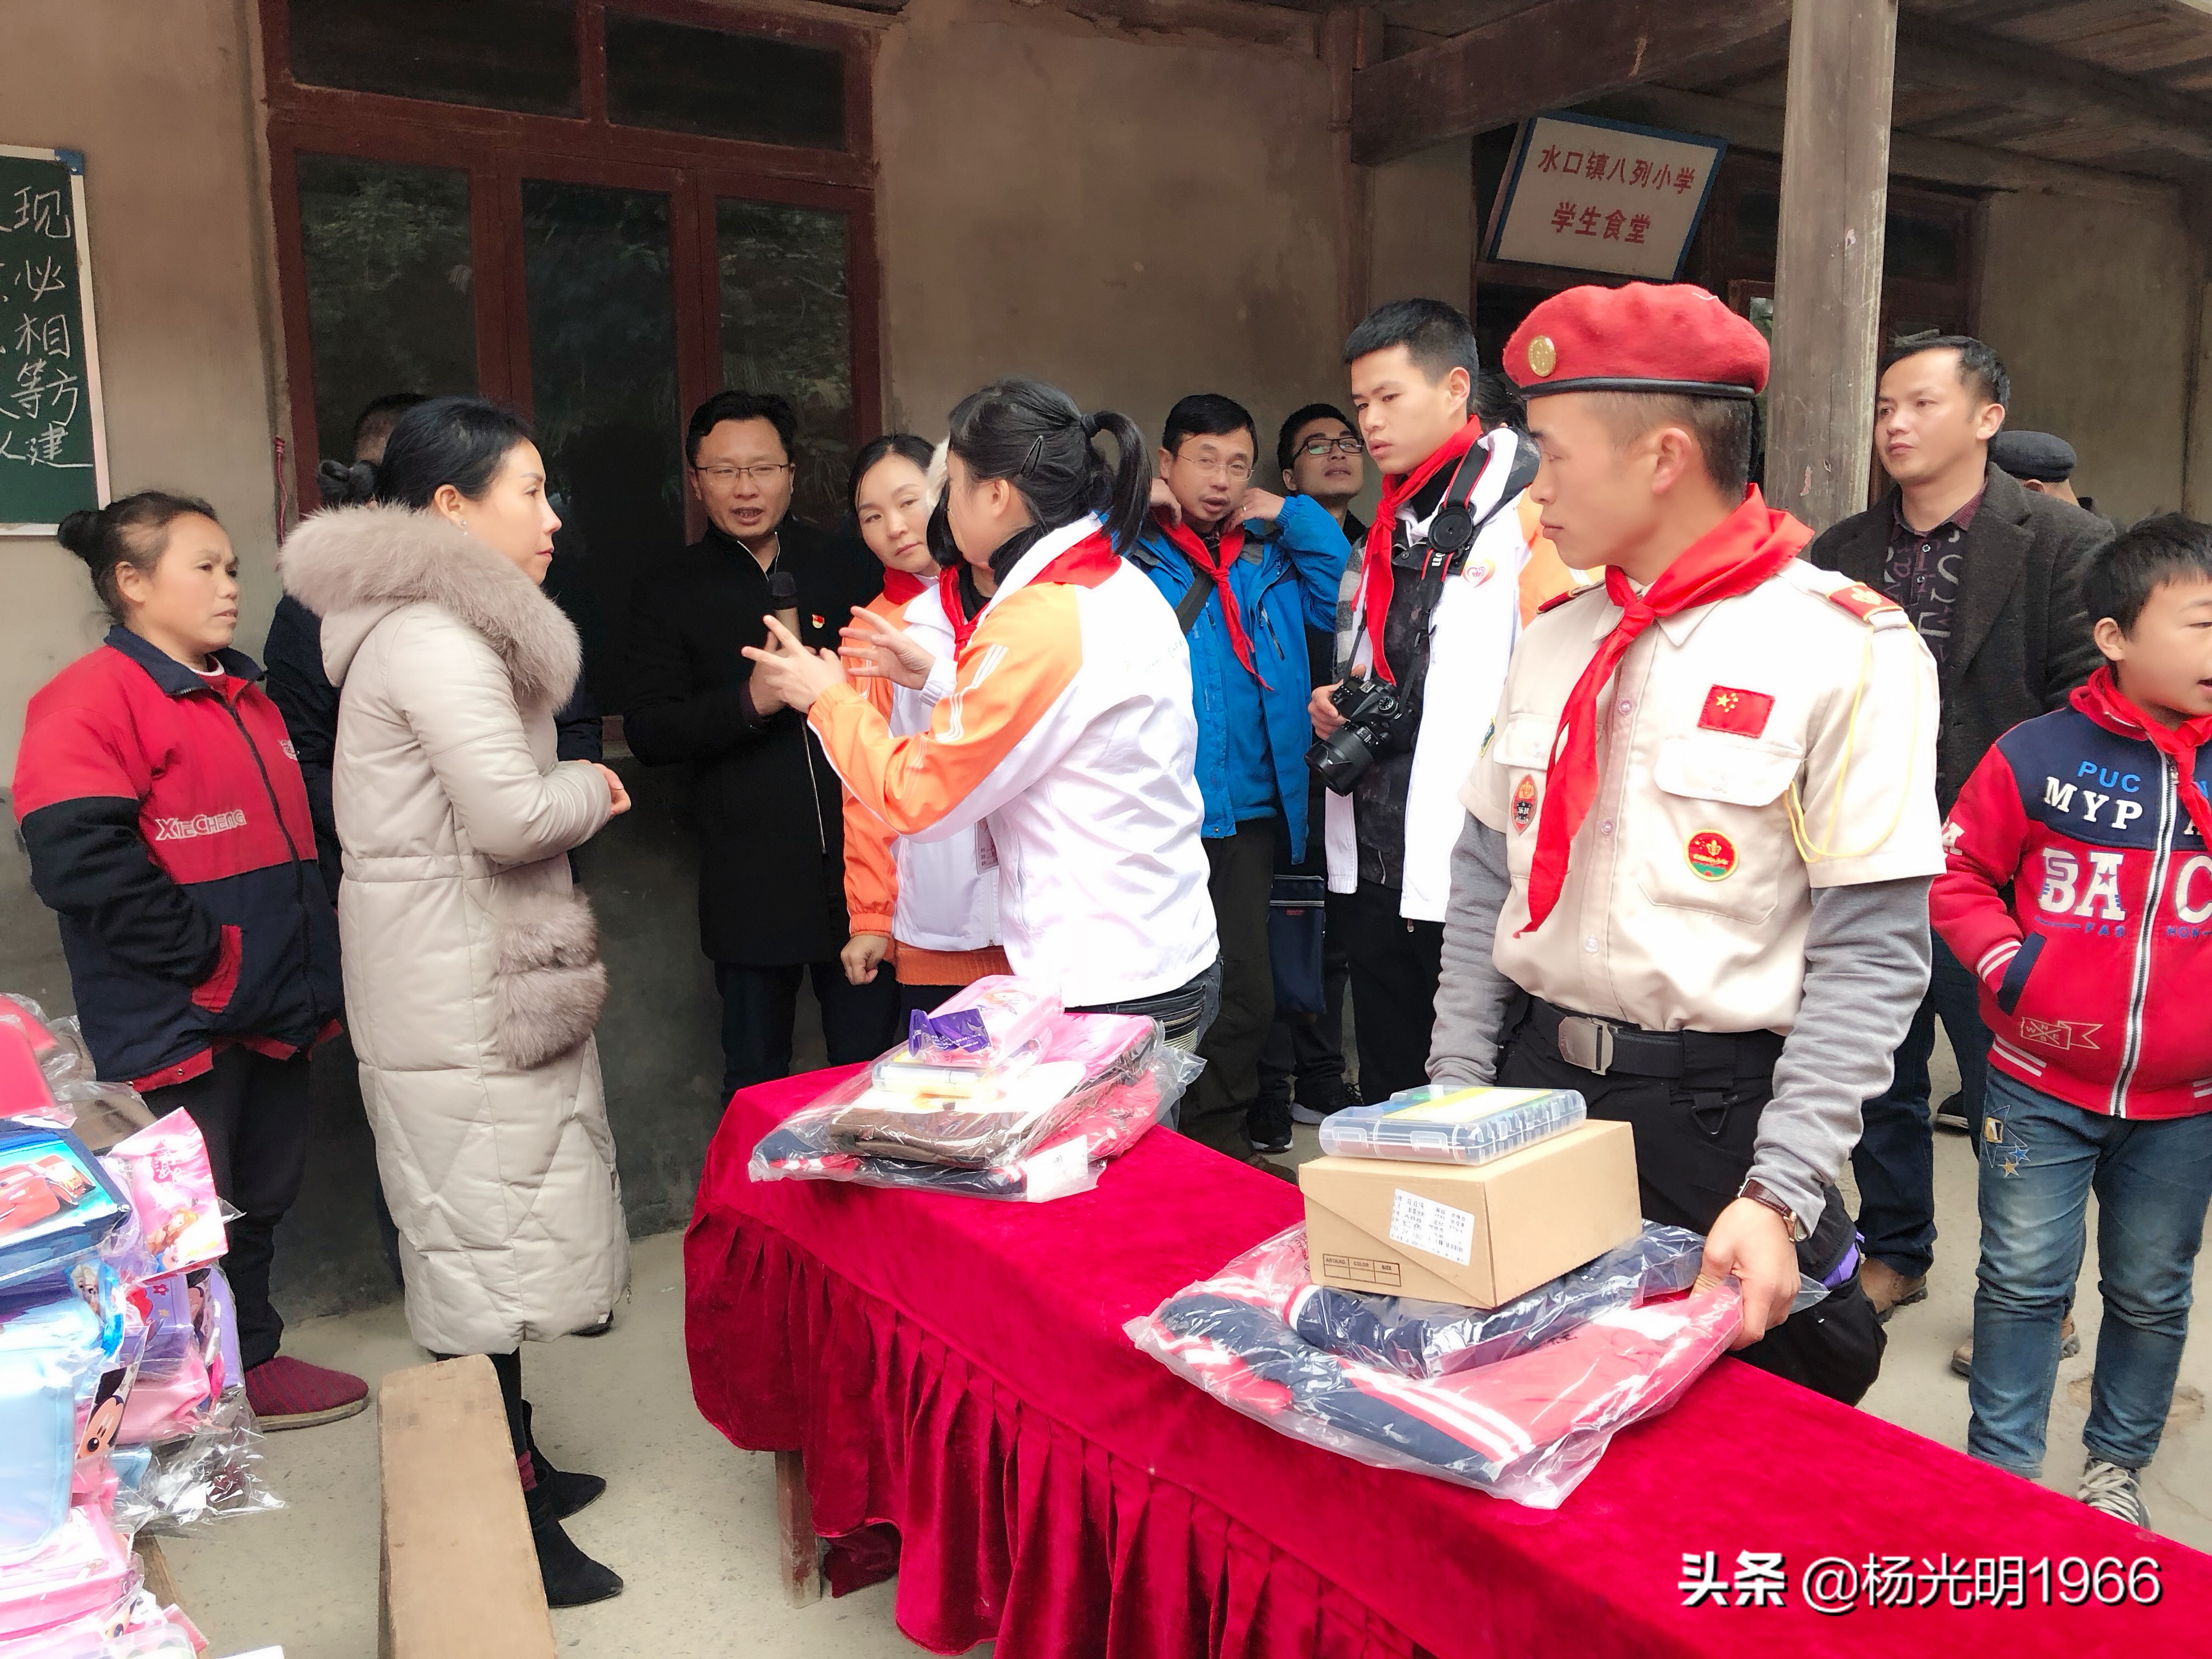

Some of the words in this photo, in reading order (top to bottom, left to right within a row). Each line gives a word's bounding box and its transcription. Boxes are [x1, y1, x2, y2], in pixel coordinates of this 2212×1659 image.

[1537, 144, 1696, 194] 水口镇八列小学
[1550, 201, 1651, 244] 学生食堂
[2076, 760, 2141, 793] PUC
[2042, 775, 2144, 830] MYP
[2038, 846, 2127, 922] BA
